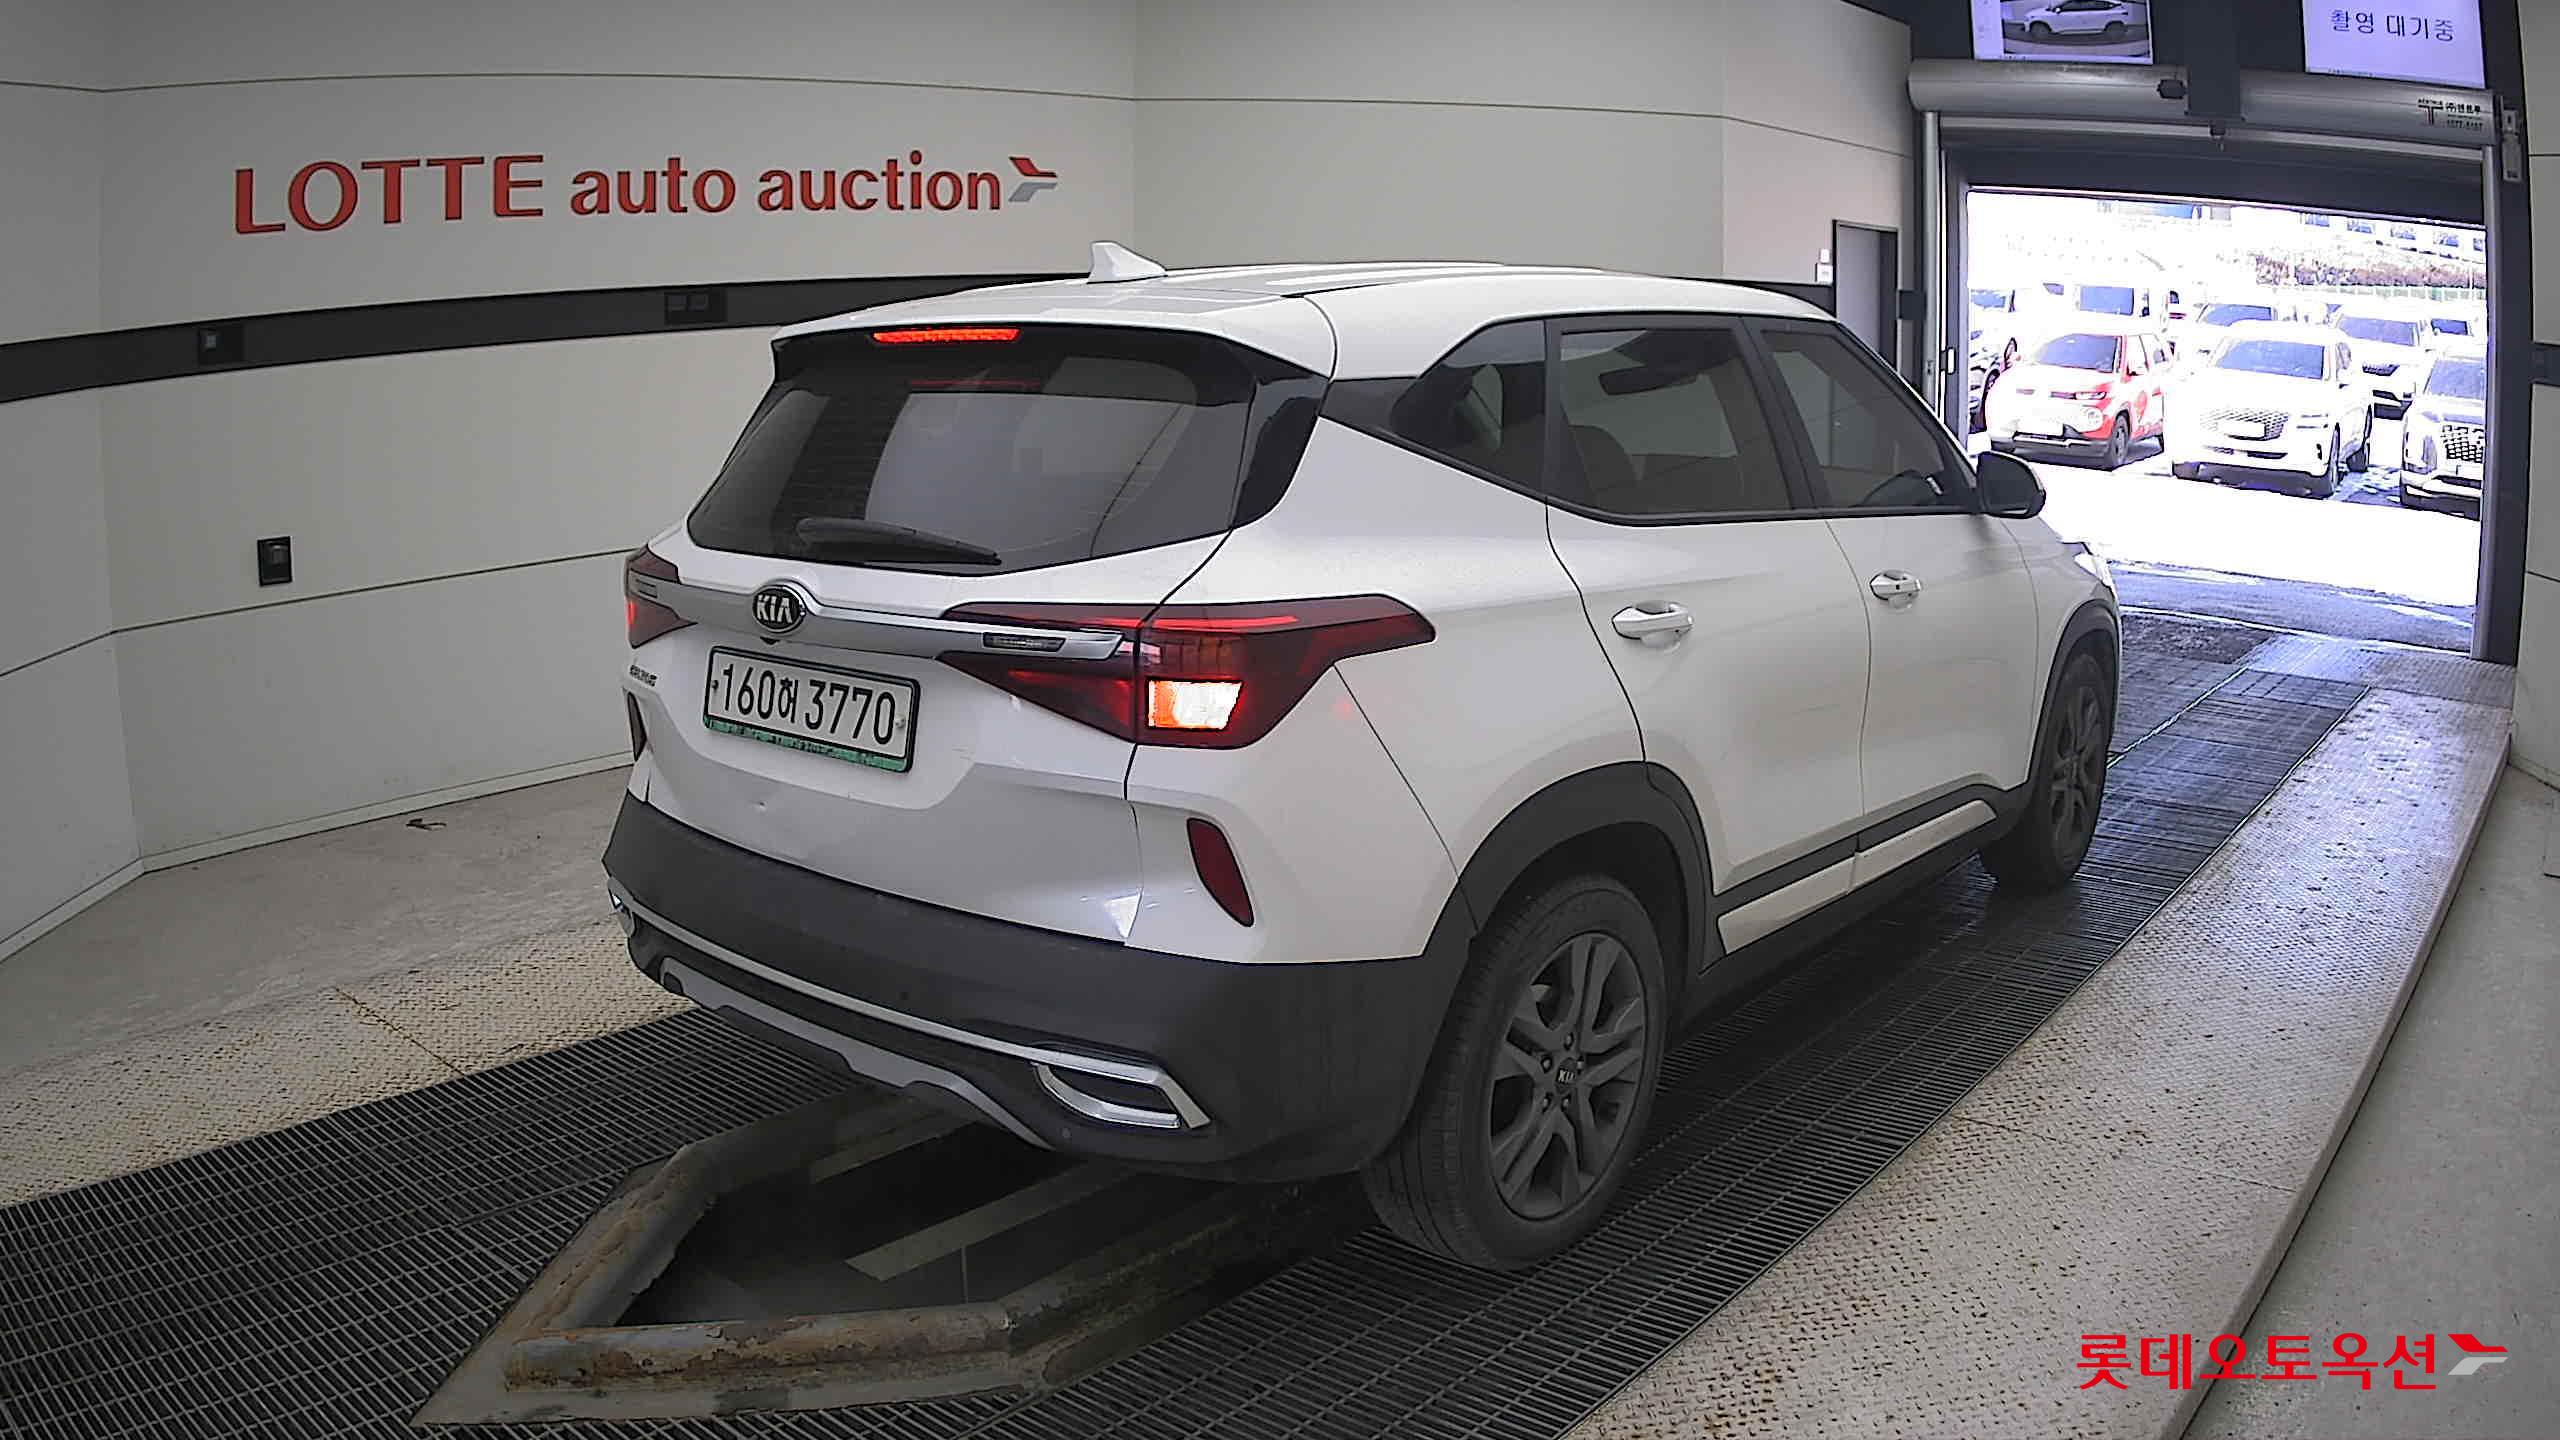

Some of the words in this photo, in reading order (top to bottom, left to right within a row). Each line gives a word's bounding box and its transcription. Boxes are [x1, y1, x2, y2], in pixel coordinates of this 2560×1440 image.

[2331, 10, 2374, 35] 촬영
[2386, 15, 2454, 42] 대기중
[235, 154, 544, 234] LOTTE
[570, 157, 737, 215] auto
[758, 150, 1002, 213] auction
[757, 594, 793, 623] KIA
[722, 663, 799, 724] 160허
[804, 679, 896, 745] 3770
